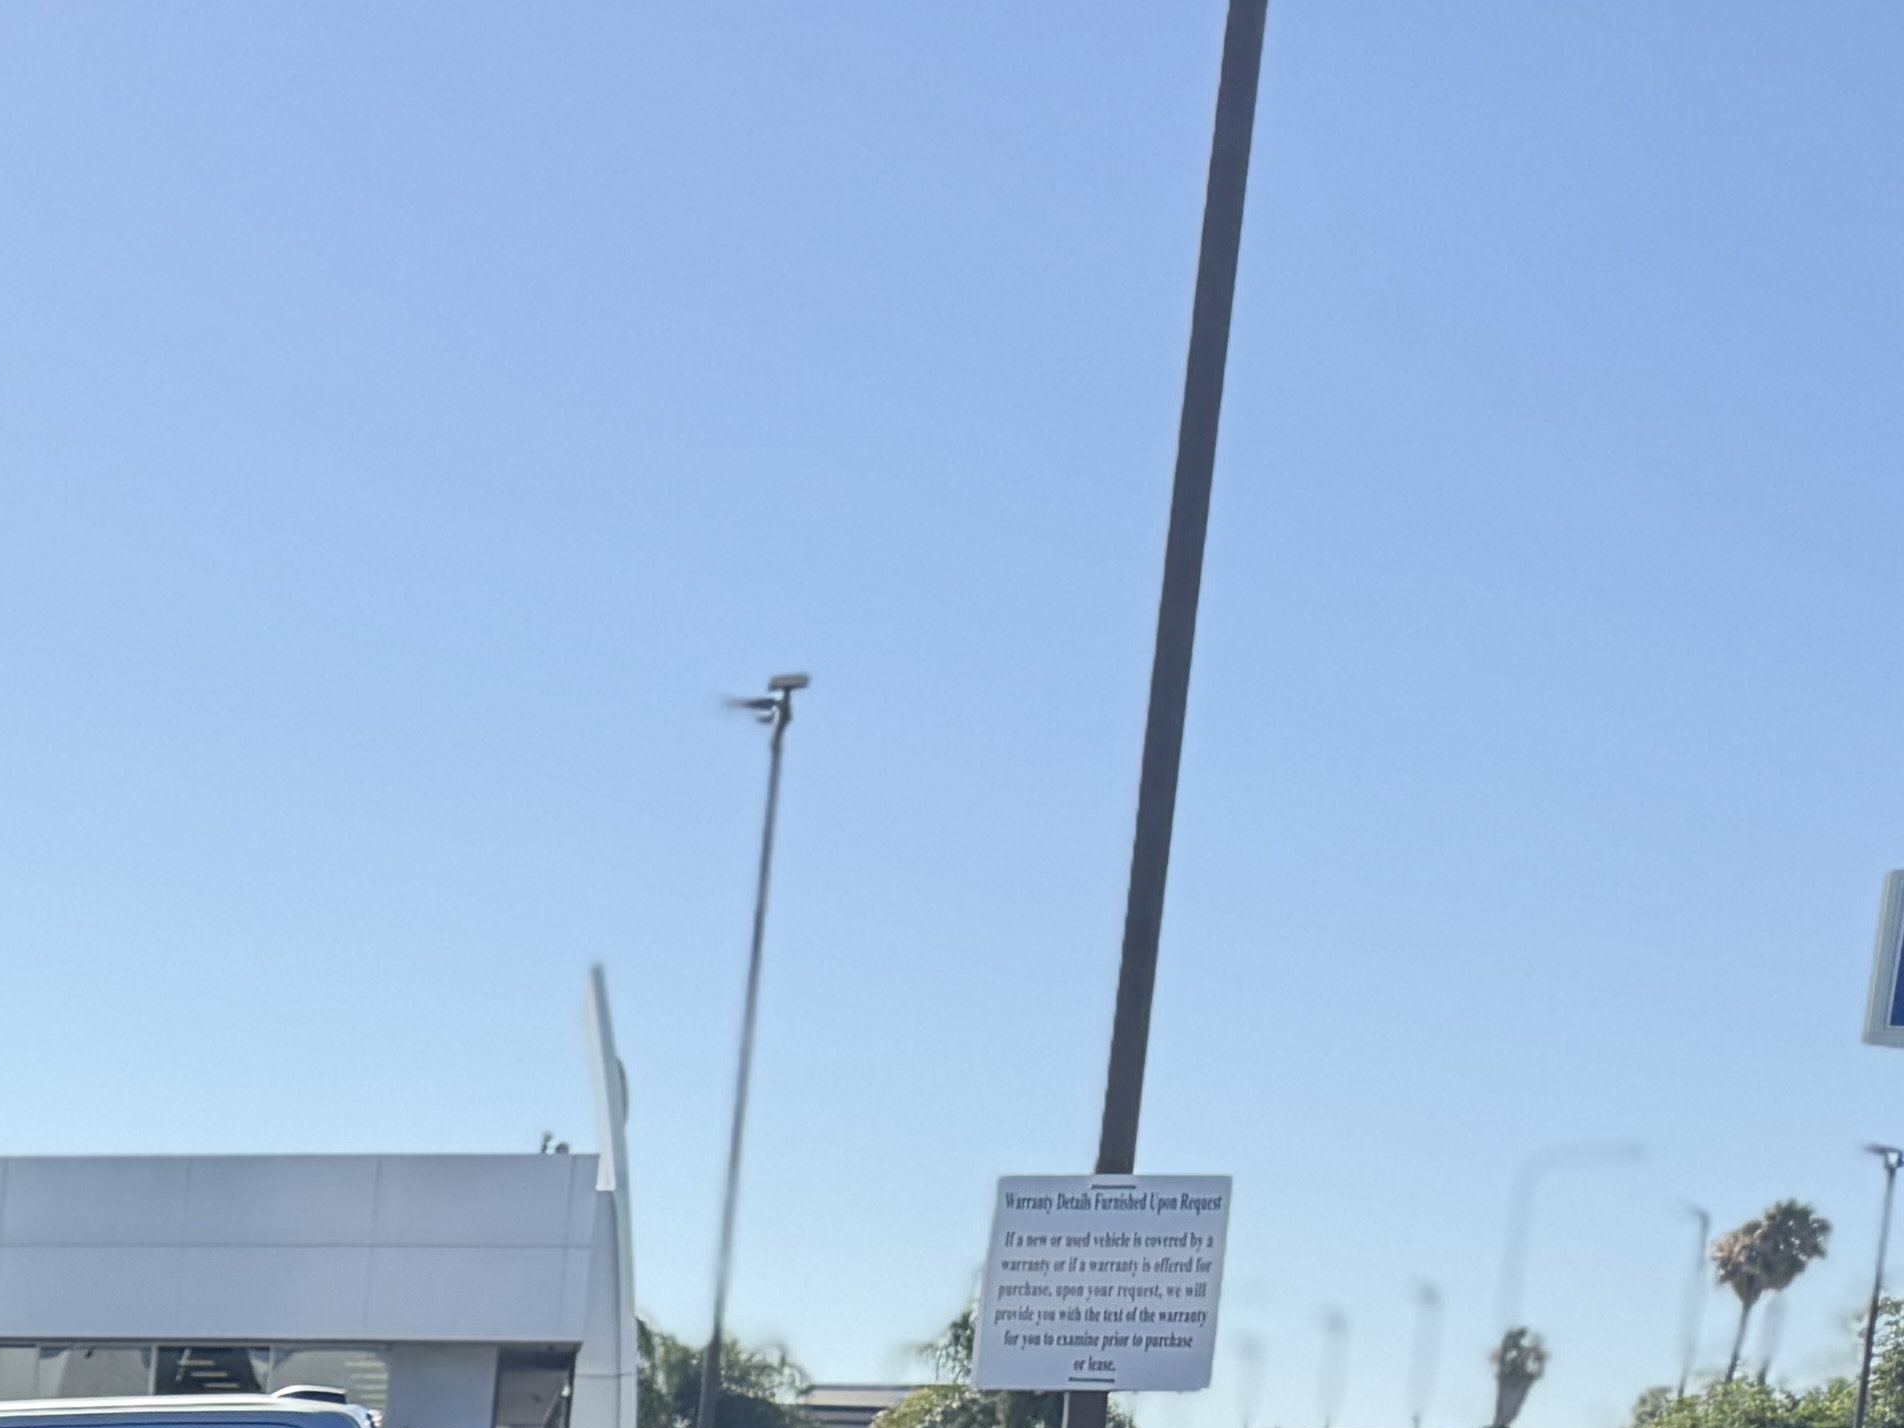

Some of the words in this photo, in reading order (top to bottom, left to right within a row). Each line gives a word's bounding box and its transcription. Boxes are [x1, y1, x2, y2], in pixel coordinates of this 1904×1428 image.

[1005, 1191, 1053, 1215] Warranty
[1056, 1192, 1091, 1210] Details
[1094, 1192, 1147, 1210] Furnished
[1150, 1192, 1177, 1215] Upon
[1180, 1192, 1222, 1215] Request
[1005, 1231, 1015, 1247] If
[1016, 1236, 1023, 1247] a
[1026, 1236, 1047, 1247] new
[1050, 1236, 1063, 1247] or
[1065, 1231, 1090, 1248] used
[1094, 1232, 1130, 1248] vehicle
[1133, 1232, 1142, 1248] is
[1145, 1232, 1187, 1248] covered
[1190, 1232, 1202, 1252] by
[1206, 1236, 1214, 1248] a
[1001, 1259, 1049, 1276] warranty
[1054, 1261, 1065, 1272] or
[1068, 1256, 1078, 1272] if
[1079, 1261, 1086, 1272] a
[1089, 1260, 1138, 1277] warranty
[1143, 1257, 1151, 1272] is
[1153, 1257, 1193, 1273] offered
[1195, 1257, 1213, 1273] for
[1056, 1285, 1084, 1301] upon
[1086, 1285, 1114, 1301] your
[1117, 1284, 1162, 1301] request,
[1167, 1286, 1181, 1298] we
[1185, 1282, 1207, 1297] will
[994, 1306, 1033, 1325] provide
[1036, 1309, 1055, 1326] you
[1059, 1306, 1081, 1321] with
[1084, 1306, 1100, 1322] the
[1103, 1308, 1123, 1322] text
[1125, 1306, 1138, 1322] of
[1139, 1306, 1155, 1322] the
[1159, 1309, 1207, 1327] warranty
[1004, 1330, 1019, 1345] for
[1021, 1333, 1041, 1350] you
[1044, 1333, 1054, 1345] to
[1056, 1330, 1099, 1346] examine
[1101, 1331, 1129, 1351] prior
[1132, 1334, 1143, 1346] to
[1144, 1331, 1193, 1352] purchase
[1074, 1360, 1085, 1371] or
[1088, 1355, 1116, 1372] lease.
